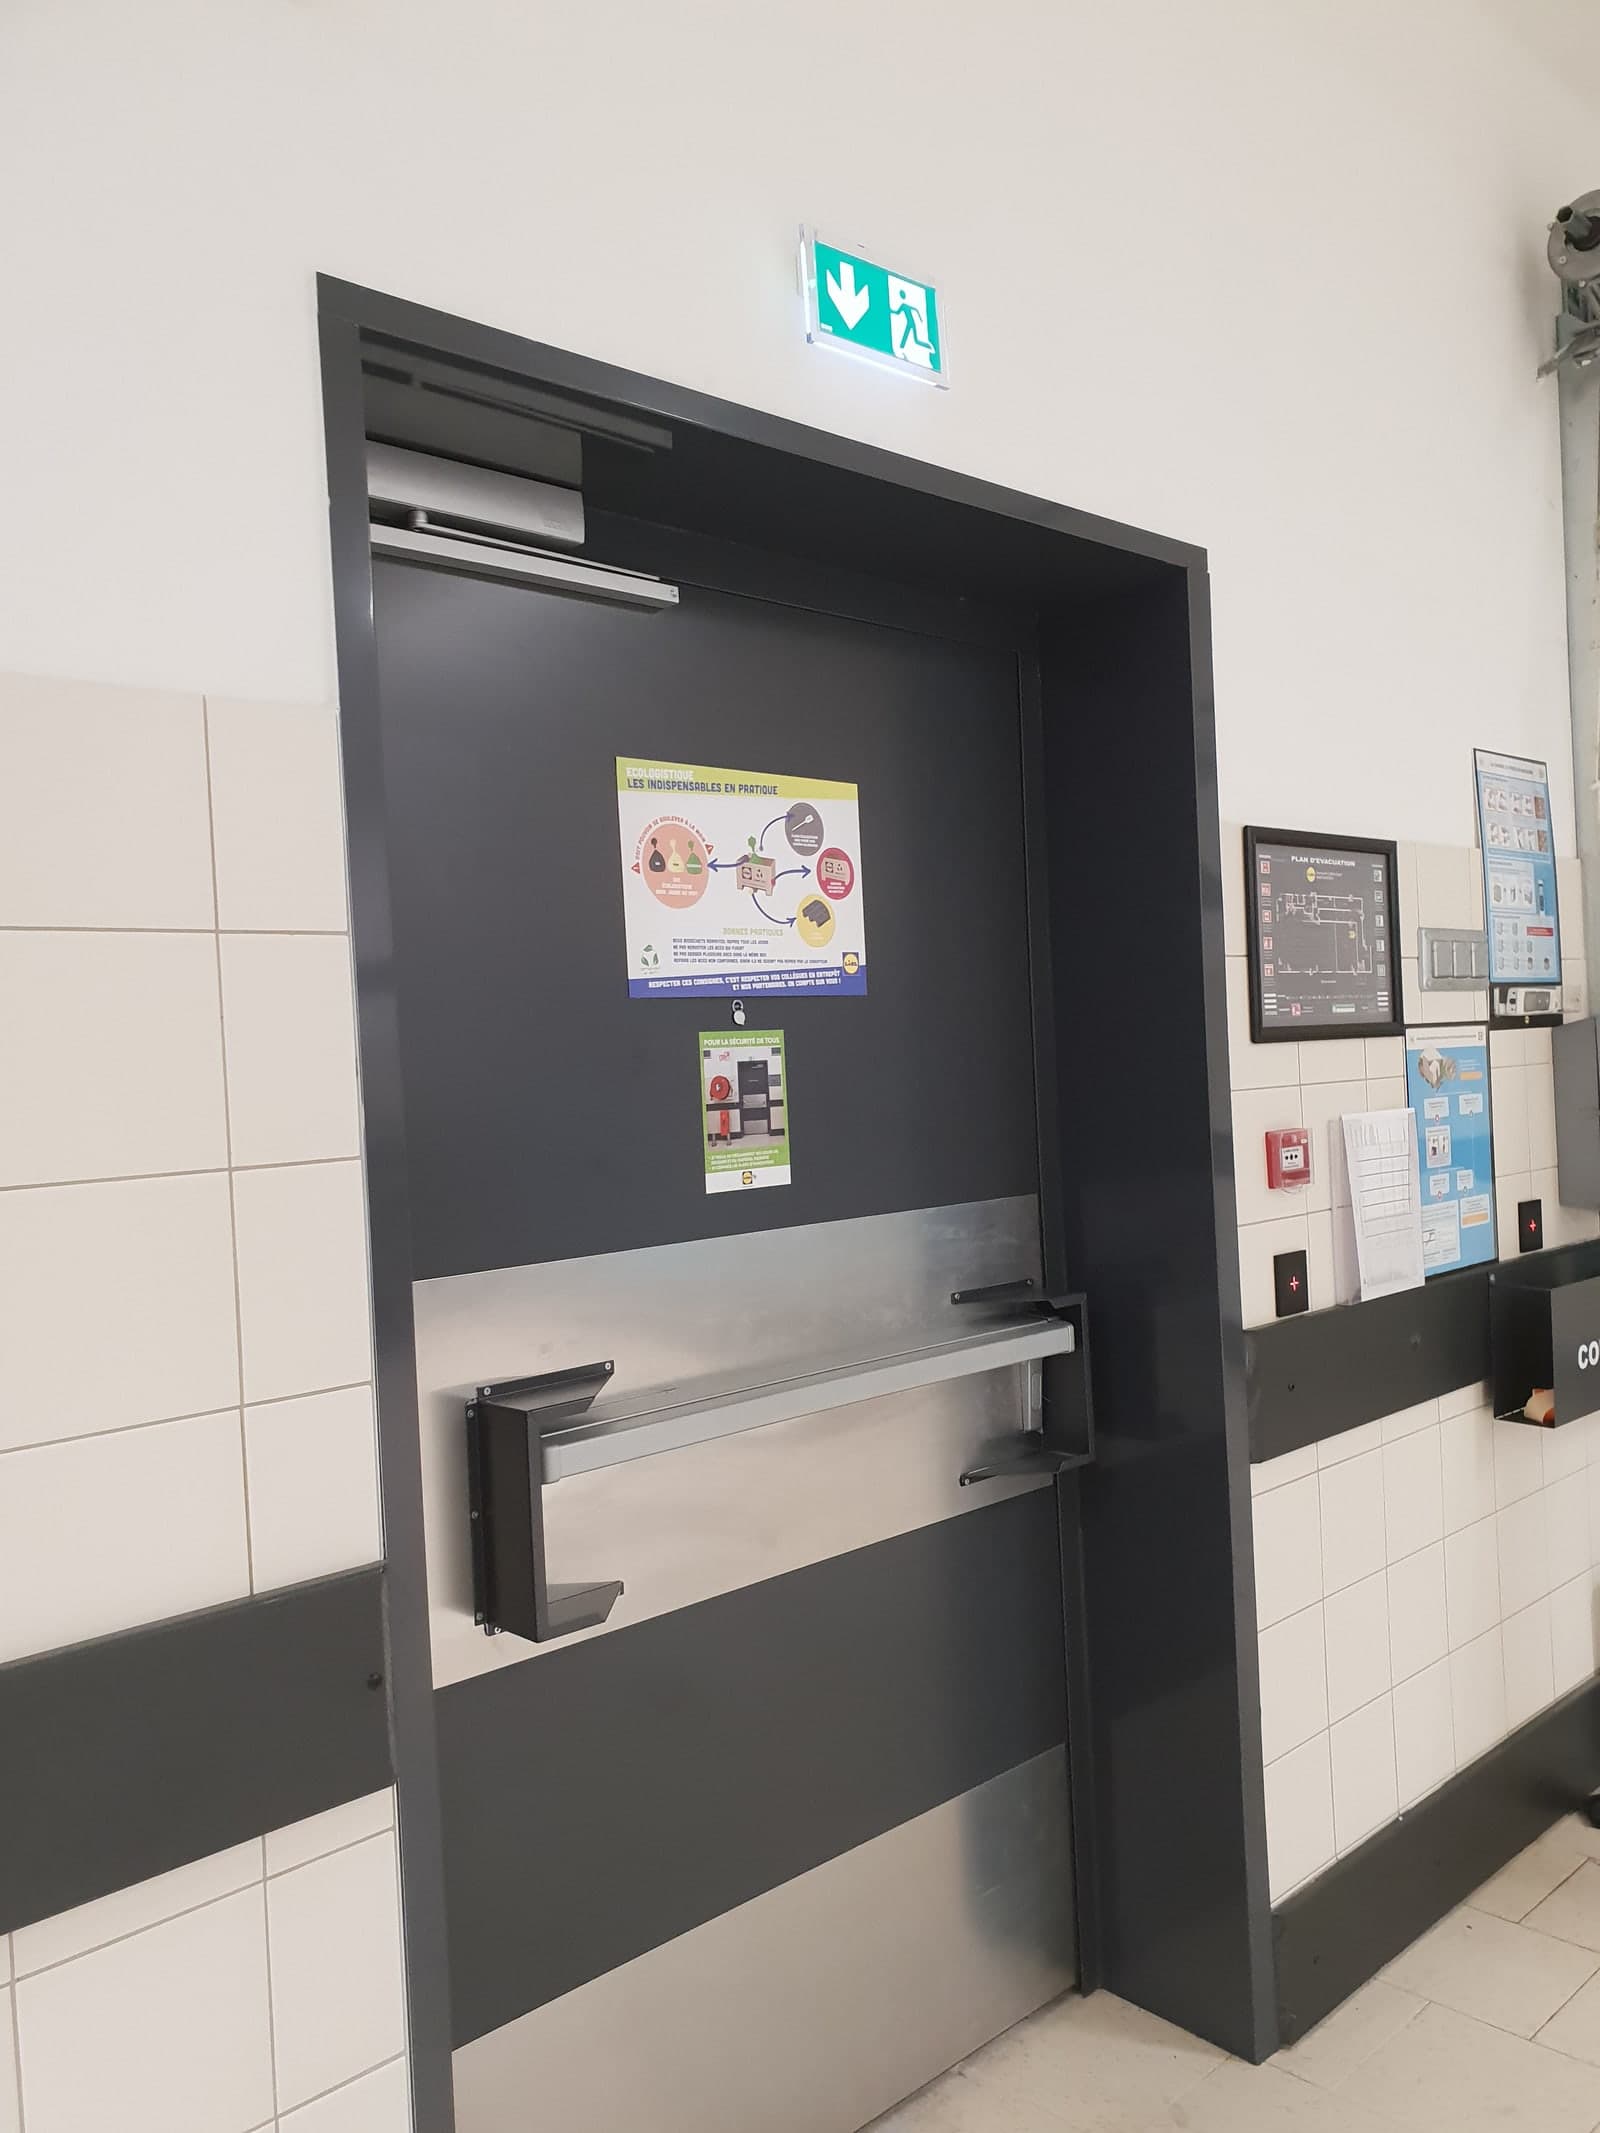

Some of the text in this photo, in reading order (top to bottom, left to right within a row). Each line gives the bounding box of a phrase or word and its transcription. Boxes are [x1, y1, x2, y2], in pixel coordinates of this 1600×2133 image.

[626, 768, 694, 779] ECOLOGISTIQUE
[627, 779, 778, 795] LES INDISPENSABLES EN PRATIQUE
[1310, 856, 1356, 867] D'EVACUATION
[729, 1037, 755, 1046] SÉCURITÉ
[1578, 1339, 1600, 1369] CO
